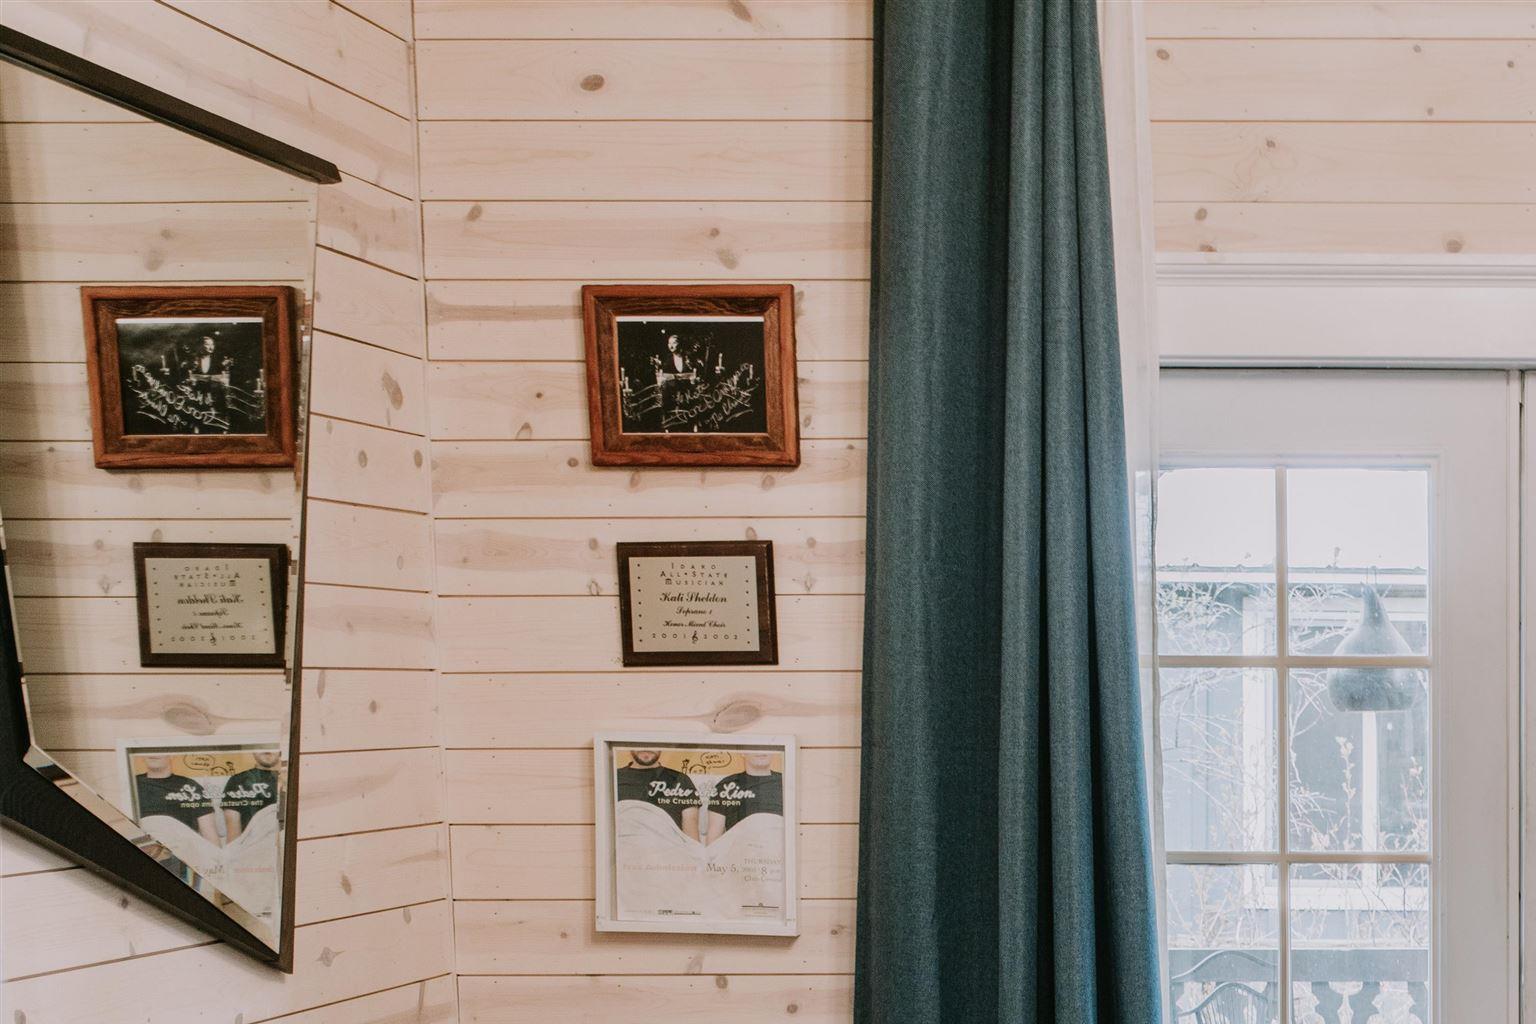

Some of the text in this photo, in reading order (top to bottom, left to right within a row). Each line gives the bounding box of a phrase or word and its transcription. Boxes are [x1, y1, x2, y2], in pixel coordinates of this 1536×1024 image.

[685, 591, 727, 603] Sheldon
[648, 780, 693, 797] Pedro
[658, 797, 670, 805] the
[721, 800, 741, 808] open
[705, 863, 727, 876] May
